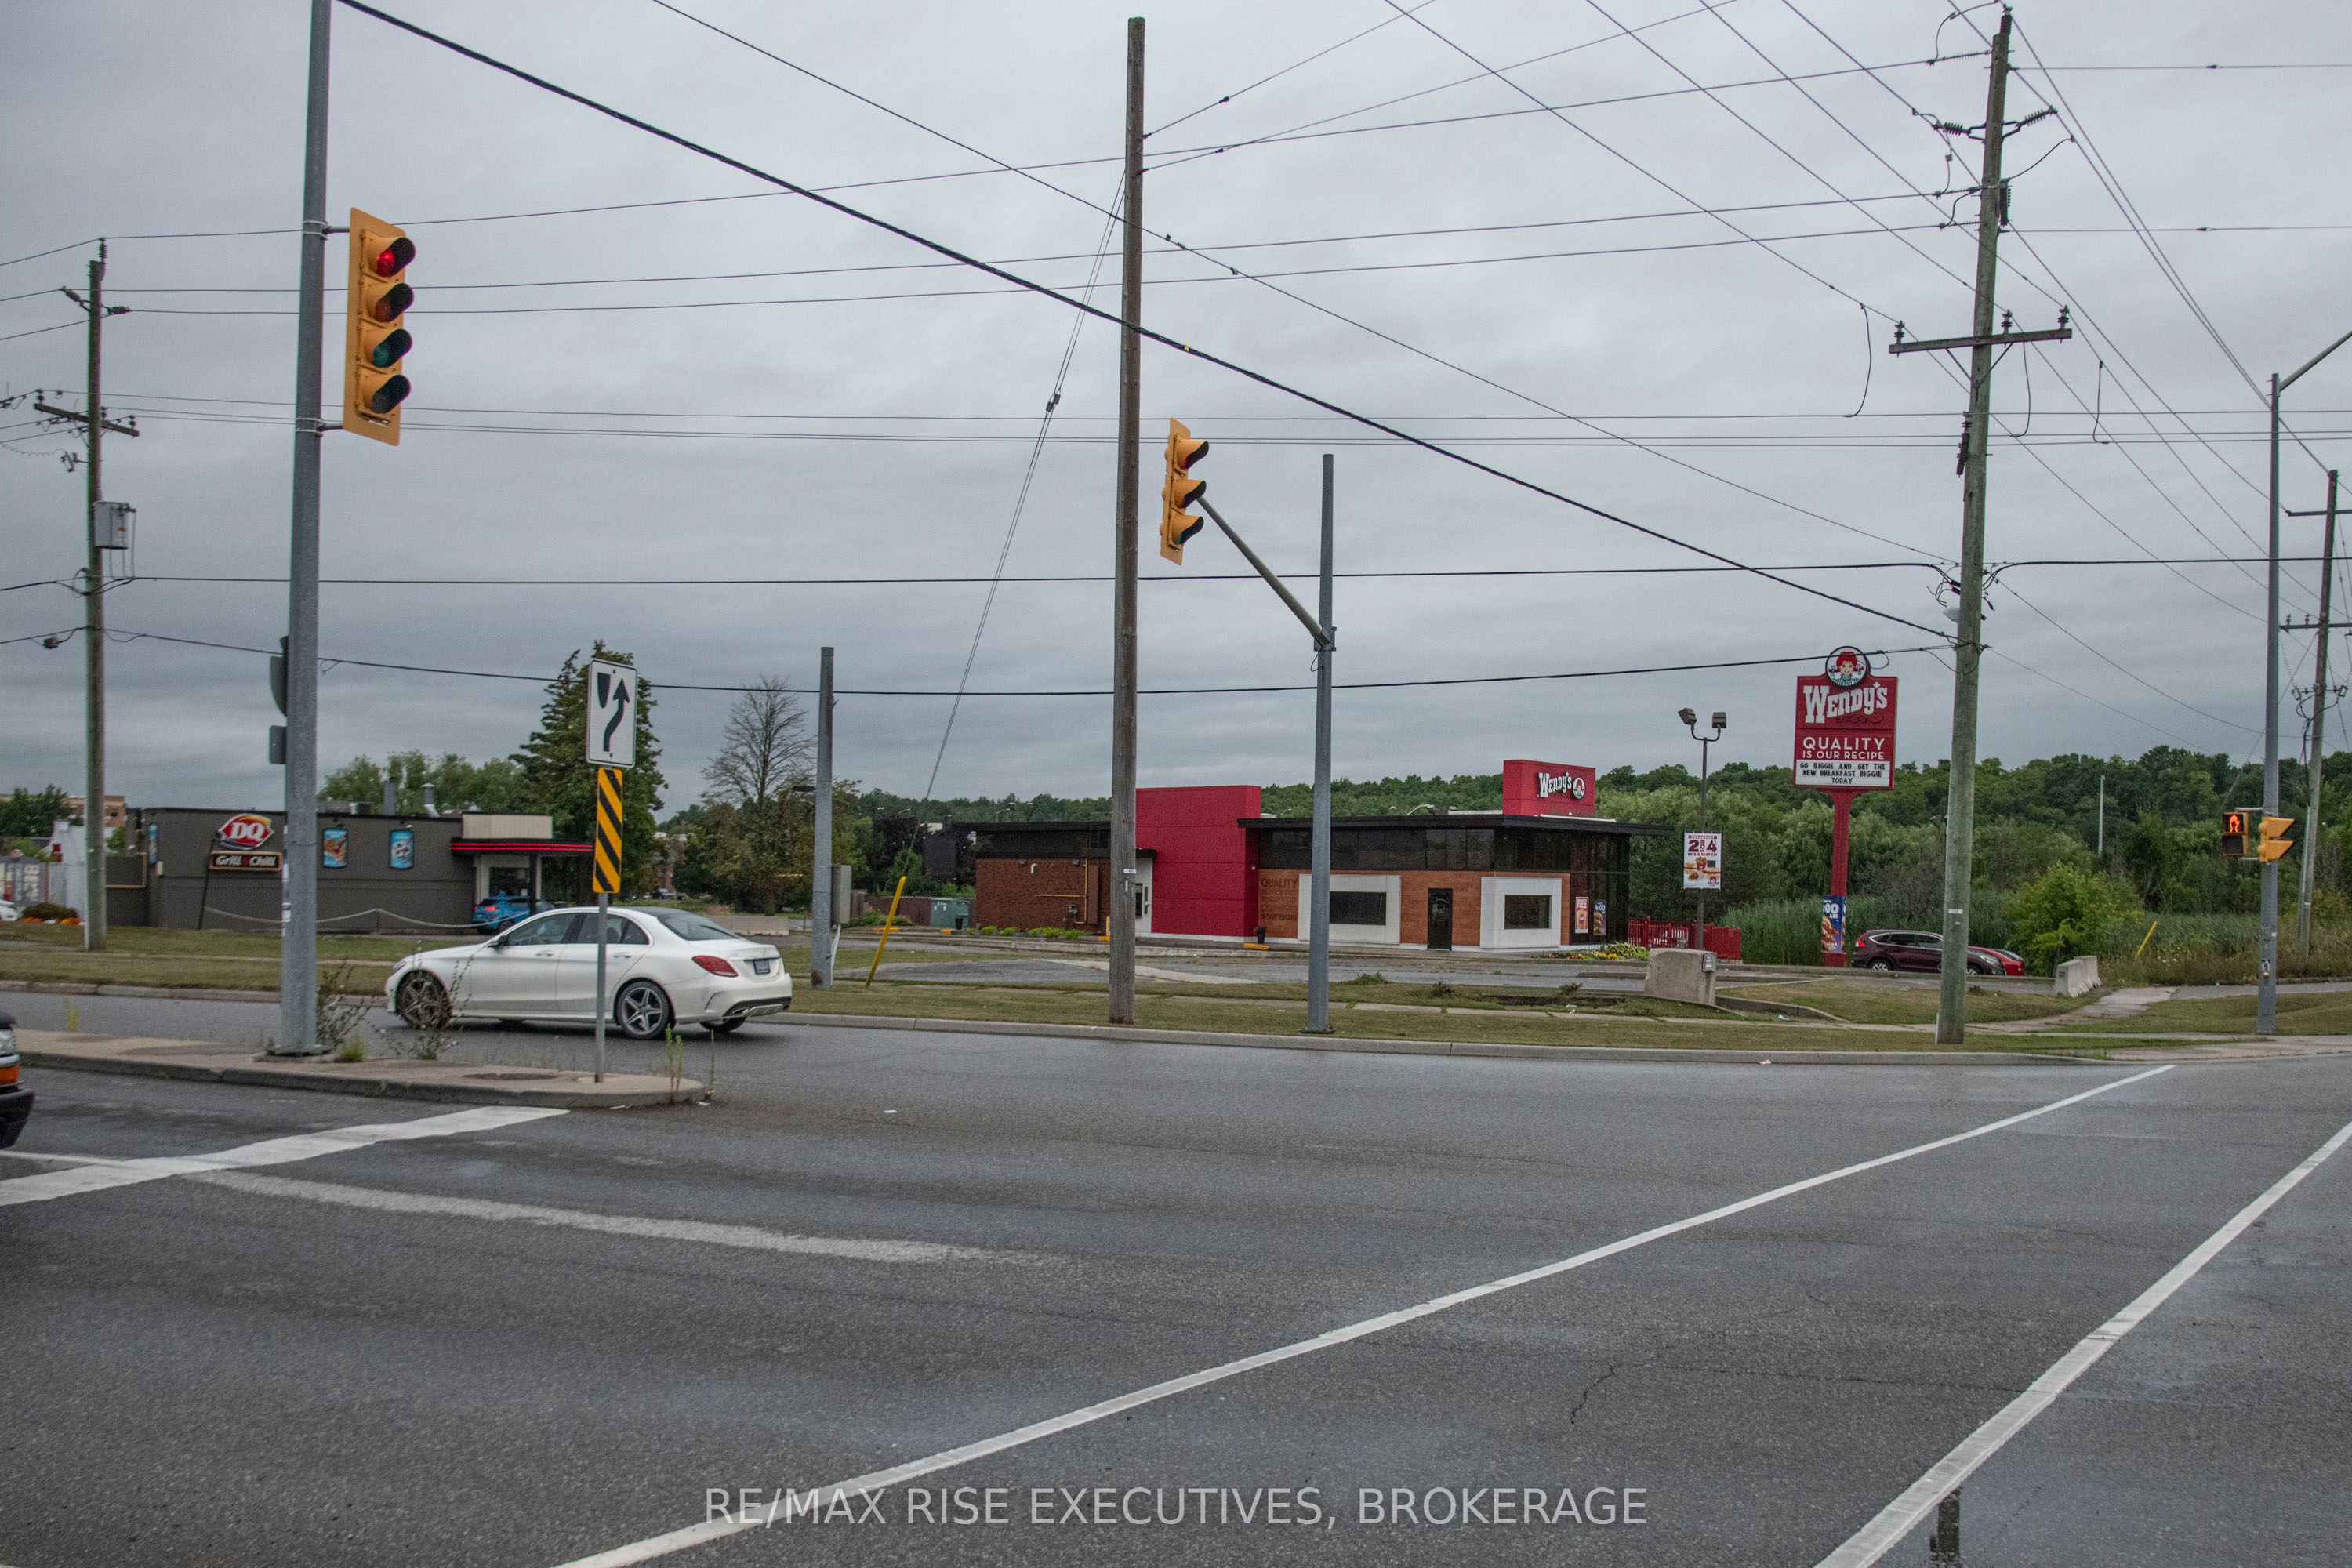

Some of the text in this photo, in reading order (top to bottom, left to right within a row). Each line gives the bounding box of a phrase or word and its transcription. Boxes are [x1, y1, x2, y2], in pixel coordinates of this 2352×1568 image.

[1802, 736, 1886, 750] QUALITY
[1802, 750, 1885, 760] IS OUR RECIPE
[230, 821, 264, 842] DQ
[1688, 839, 1700, 852] 2
[1706, 840, 1718, 853] 4
[215, 855, 277, 866] Grill Chill
[1261, 877, 1298, 888] QUALITY
